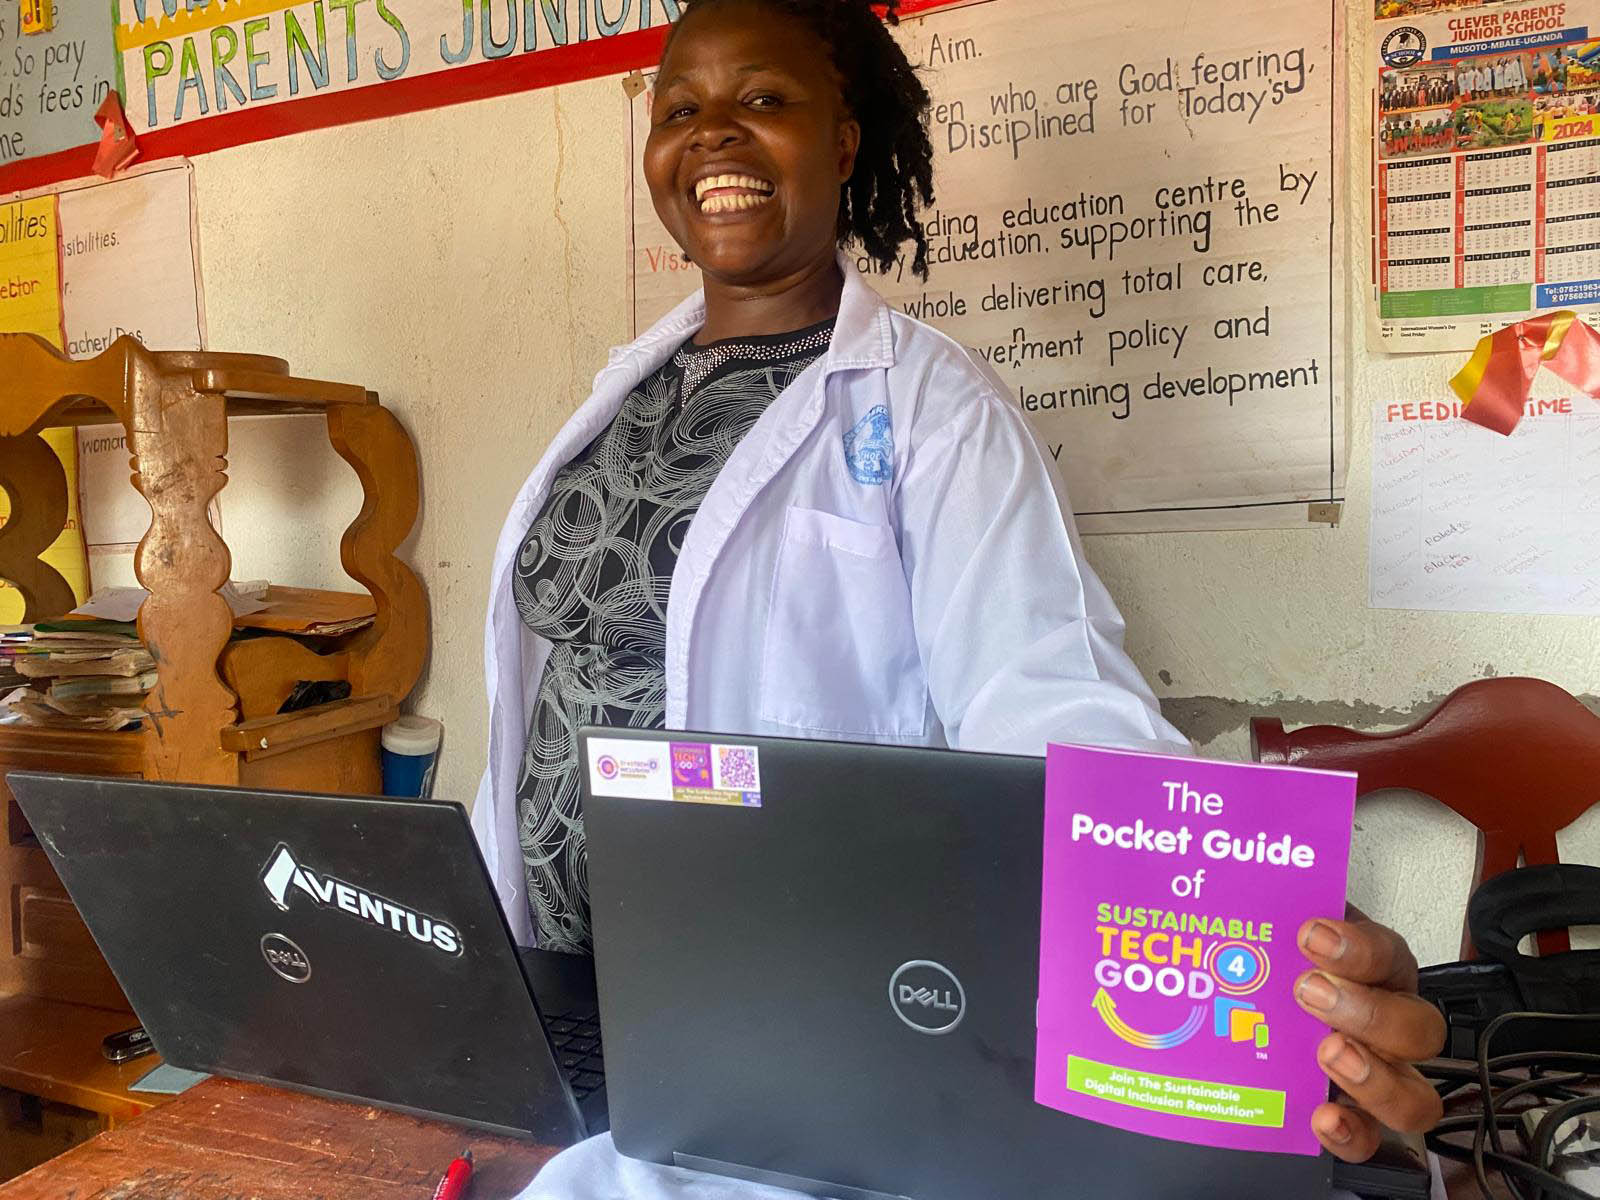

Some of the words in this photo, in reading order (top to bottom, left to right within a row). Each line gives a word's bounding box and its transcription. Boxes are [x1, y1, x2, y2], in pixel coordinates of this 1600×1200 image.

[1448, 14, 1499, 31] CLEVER
[1503, 3, 1566, 24] PARENTS
[1451, 26, 1501, 43] JUNIOR
[1506, 16, 1565, 36] SCHOOL
[13, 46, 35, 78] So
[44, 40, 86, 82] pay
[143, 0, 410, 127] PARENTS
[928, 33, 983, 67] Aim.
[1450, 32, 1564, 55] MUSOTO-MBALE-UGANDA
[39, 83, 84, 115] fees
[990, 81, 1037, 116] who
[1056, 78, 1099, 104] are
[1118, 58, 1173, 97] God
[1191, 47, 1316, 95] fearing,
[948, 101, 1096, 160] Disciplined
[1119, 98, 1156, 127] for
[1178, 79, 1284, 124] Today's
[1552, 119, 1593, 140] 2024
[1002, 190, 1124, 230] education
[1154, 176, 1246, 211] centre
[1279, 164, 1318, 205] by
[1061, 209, 1213, 261] supporting
[1234, 197, 1281, 228] the
[903, 290, 968, 321] whole
[980, 276, 1107, 318] delivering
[1121, 263, 1183, 296] total
[1202, 258, 1269, 287] care,
[1108, 319, 1188, 366] policy
[1213, 306, 1271, 340] and
[1019, 382, 1131, 420] learning
[1142, 358, 1320, 406] development
[1162, 780, 1225, 816] The
[1071, 813, 1193, 855] Pocket
[1202, 829, 1316, 868] Guide
[1171, 868, 1206, 899] of
[1096, 902, 1274, 943] SUSTAINABLE
[1095, 925, 1203, 969] TECH
[1226, 954, 1246, 978] 4
[898, 984, 959, 1011] DELL
[1094, 958, 1215, 1000] GOOD
[1084, 1078, 1126, 1097] Digital
[1127, 1087, 1184, 1109] Inclusion
[1108, 1070, 1135, 1086] Join
[1137, 1076, 1161, 1091] The
[1164, 1080, 1241, 1102] Sustainable
